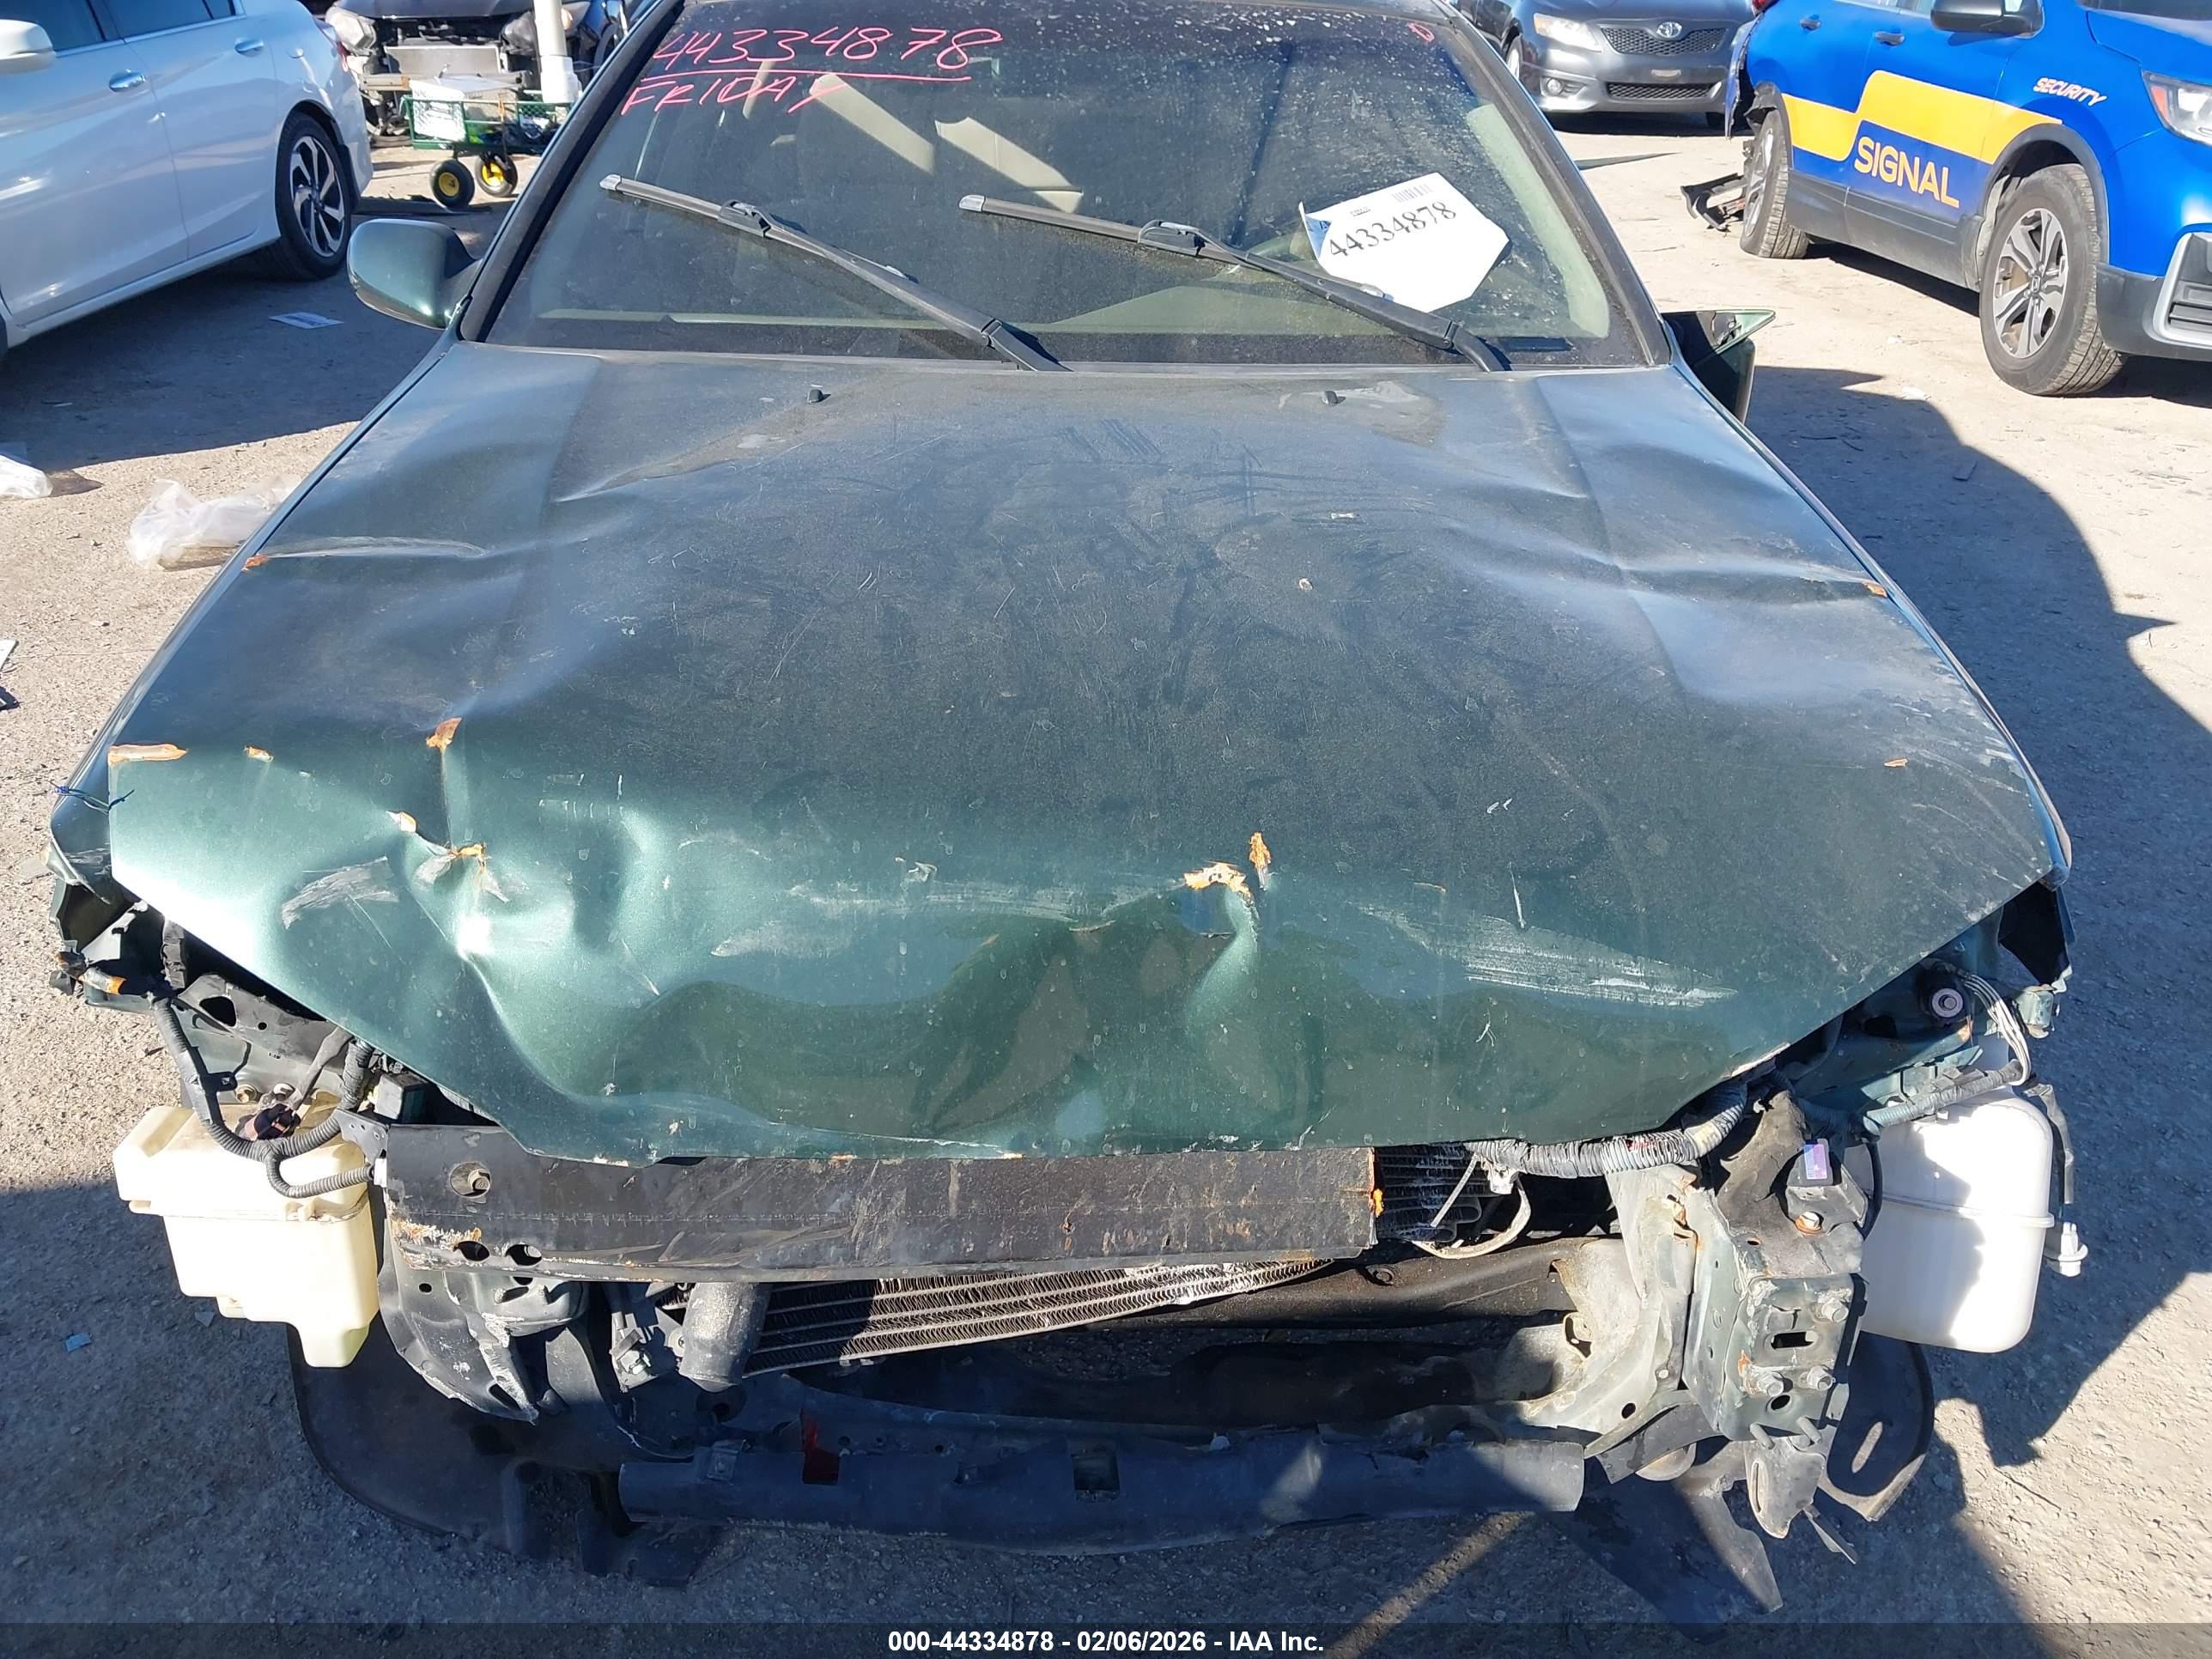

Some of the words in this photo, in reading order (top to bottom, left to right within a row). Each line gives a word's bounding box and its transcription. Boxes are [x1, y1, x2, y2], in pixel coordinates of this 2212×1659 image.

[621, 76, 848, 115] FRIDAY
[2033, 76, 2107, 106] SECURITY
[1854, 136, 1960, 209] SIGNAL
[1329, 201, 1456, 257] 44334878
